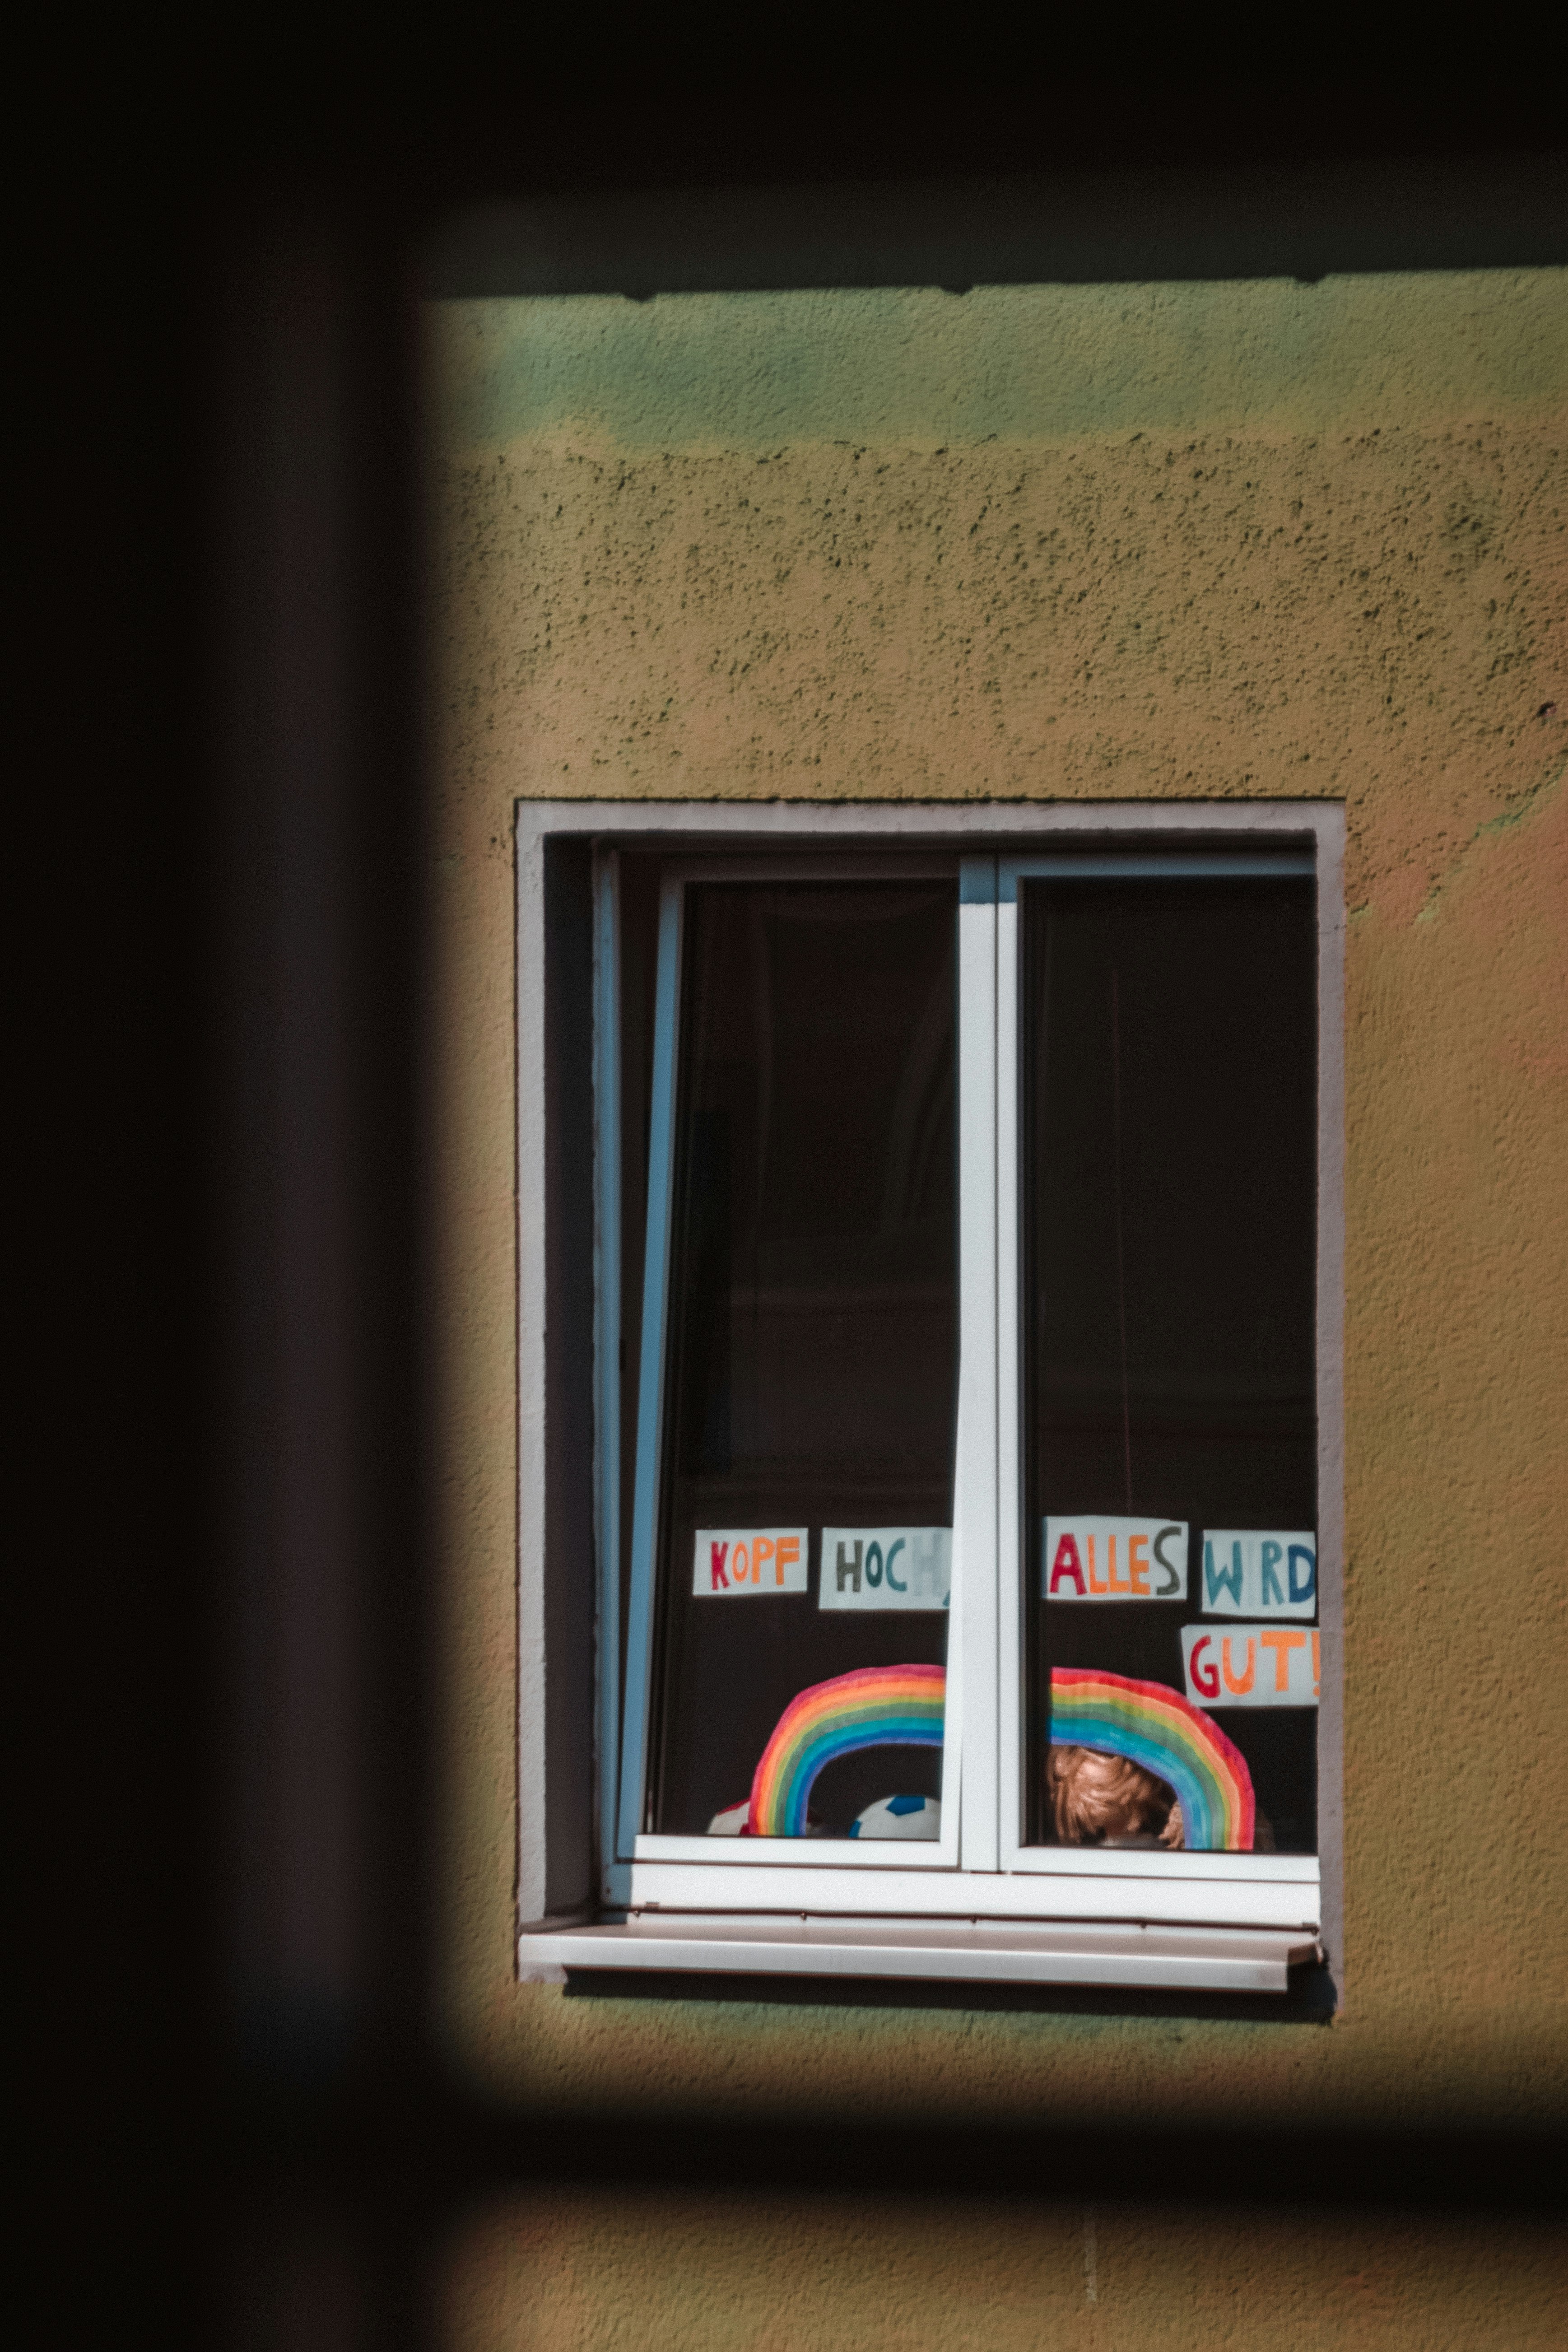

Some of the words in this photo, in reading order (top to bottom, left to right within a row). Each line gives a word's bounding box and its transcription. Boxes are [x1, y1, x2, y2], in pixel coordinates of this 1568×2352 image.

[711, 1536, 800, 1591] KOPF
[1049, 1526, 1182, 1596] ALLES
[1204, 1540, 1316, 1608] WIRD
[1189, 1630, 1321, 1699] GUT!
